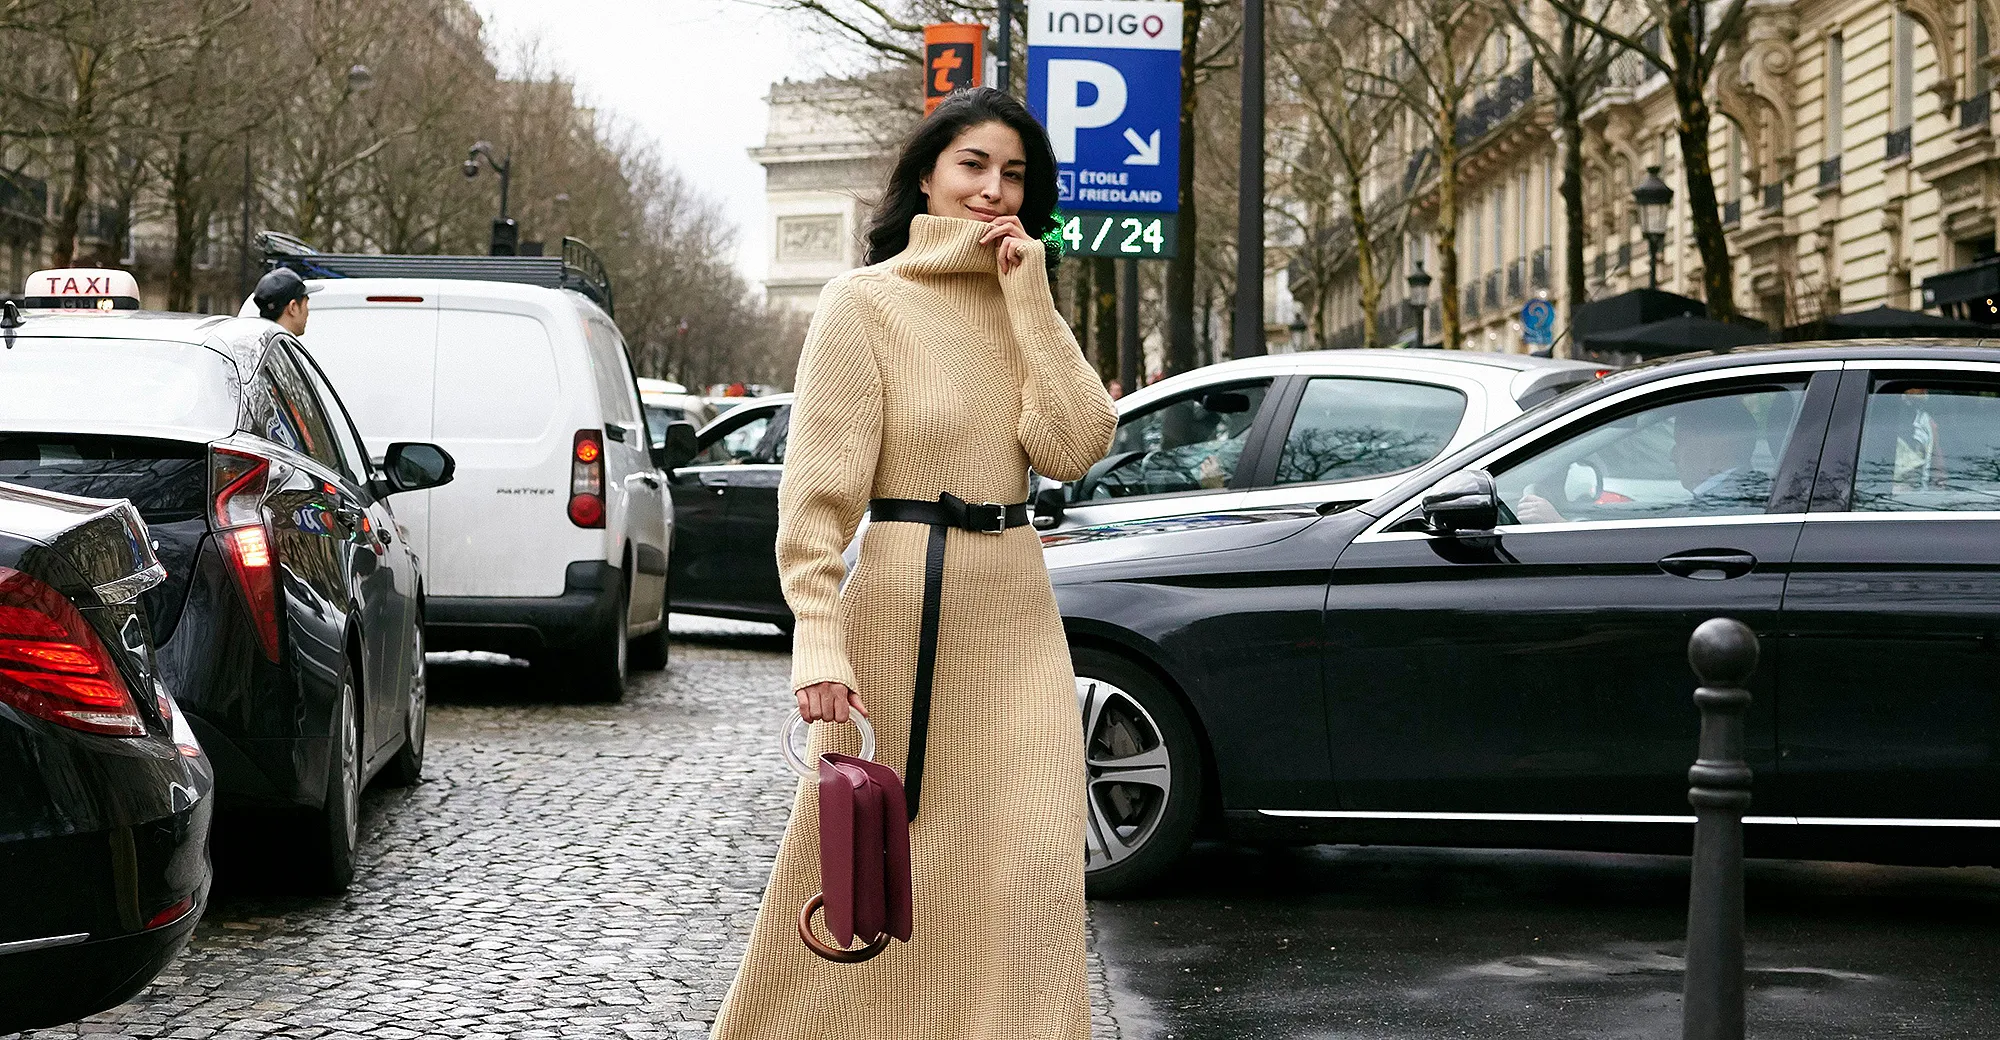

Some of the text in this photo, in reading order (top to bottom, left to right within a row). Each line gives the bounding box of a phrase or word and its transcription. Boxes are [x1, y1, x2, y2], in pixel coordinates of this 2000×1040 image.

[1048, 12, 1163, 38] INDIGO
[932, 48, 963, 92] t
[1046, 58, 1128, 163] P
[1079, 169, 1128, 185] ÉTOILE
[1078, 187, 1162, 204] FRIEDLAND
[46, 277, 110, 295] TAXI
